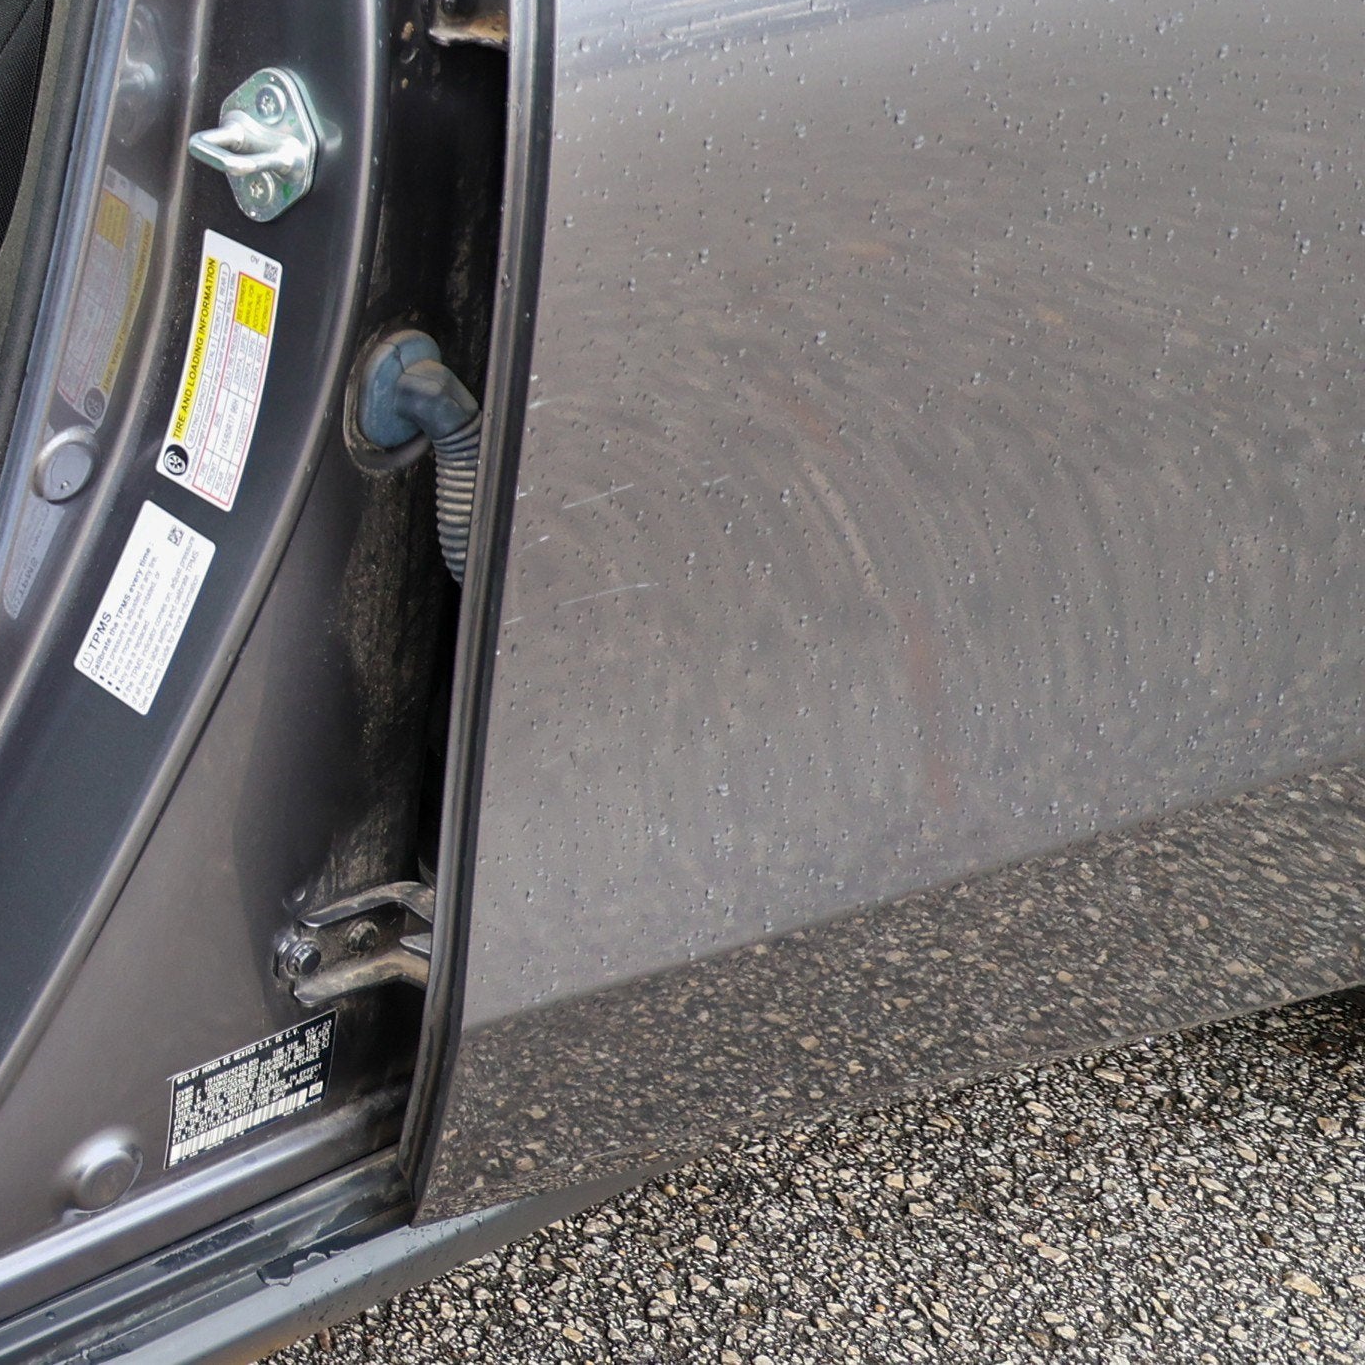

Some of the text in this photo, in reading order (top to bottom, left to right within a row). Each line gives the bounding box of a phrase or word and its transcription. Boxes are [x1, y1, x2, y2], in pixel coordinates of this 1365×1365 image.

[172, 258, 215, 438] TIRE AND LOADING INFORMATION
[87, 611, 111, 650] TPMS
[90, 547, 151, 676] Calibrate the TPMS every time
